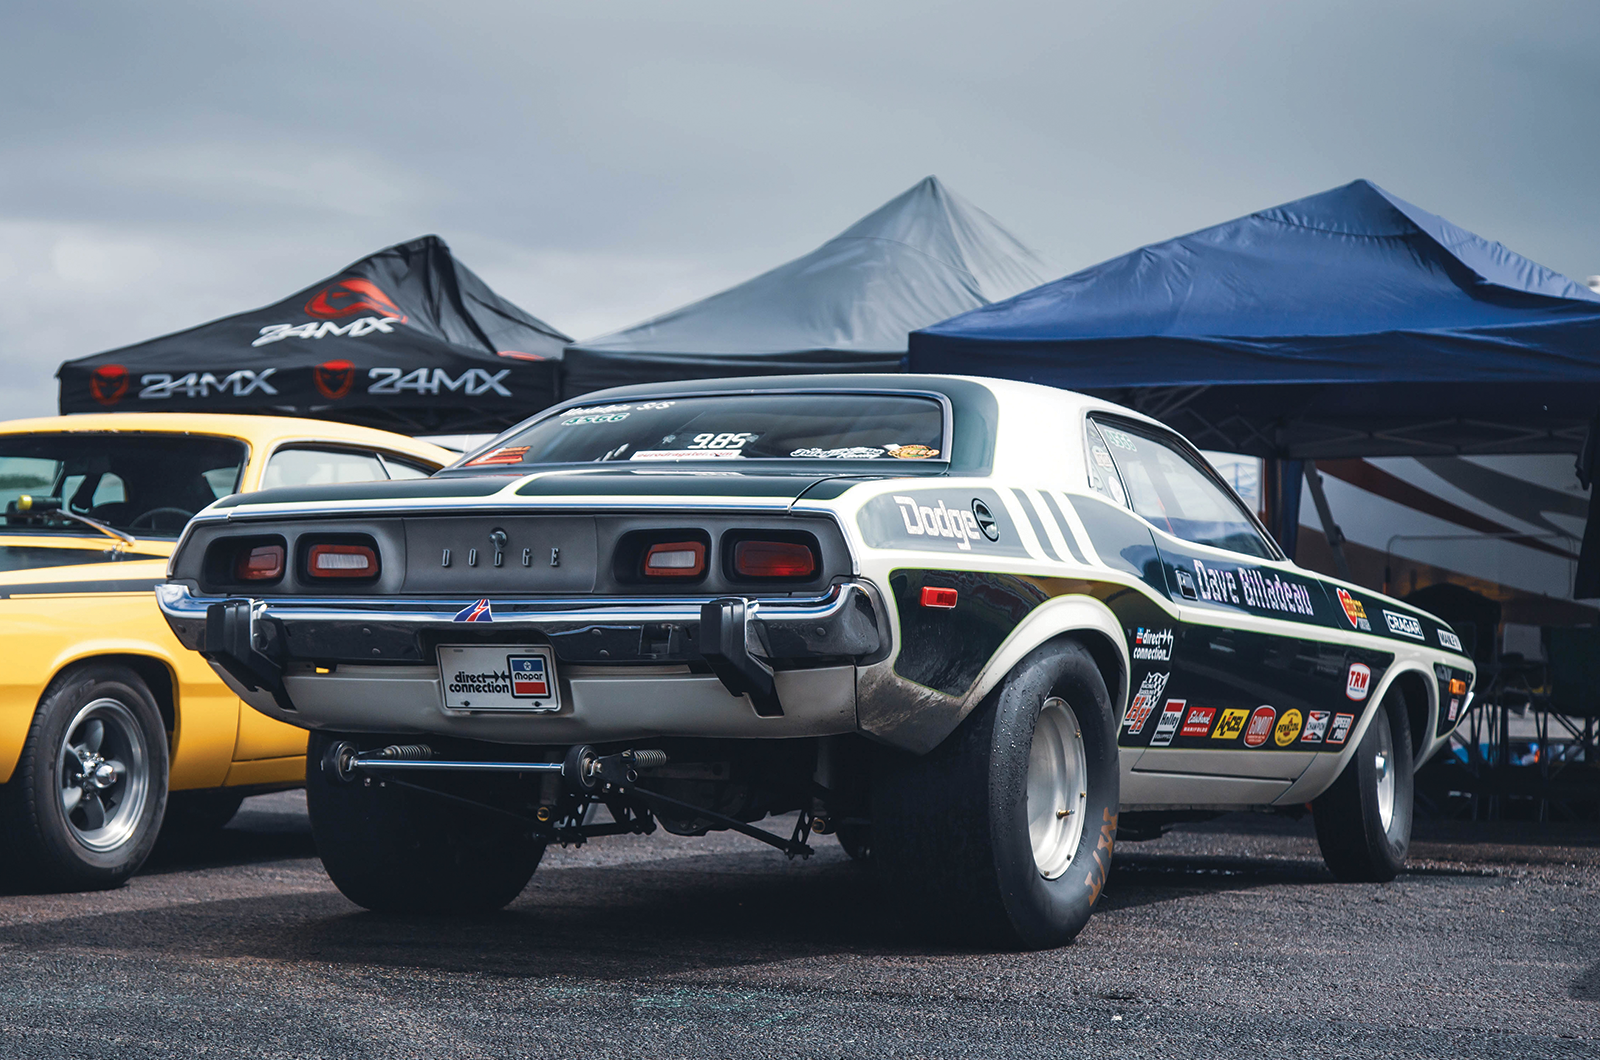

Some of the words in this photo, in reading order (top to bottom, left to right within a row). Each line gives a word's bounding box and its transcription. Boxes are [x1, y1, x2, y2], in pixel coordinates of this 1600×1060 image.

[251, 316, 393, 348] 24MX
[138, 367, 279, 399] 24MX
[368, 367, 513, 398] 24MX
[687, 432, 752, 449] 9.85
[892, 495, 982, 551] Dodge
[441, 547, 560, 567] DODGE
[1193, 559, 1240, 604] Dave
[1386, 614, 1422, 636] CRAGAR
[1142, 628, 1161, 645] direct
[1133, 645, 1168, 660] connection
[454, 670, 486, 684] direct
[1349, 670, 1369, 689] TRW
[449, 681, 510, 694] connection
[1159, 712, 1180, 729] Holley
